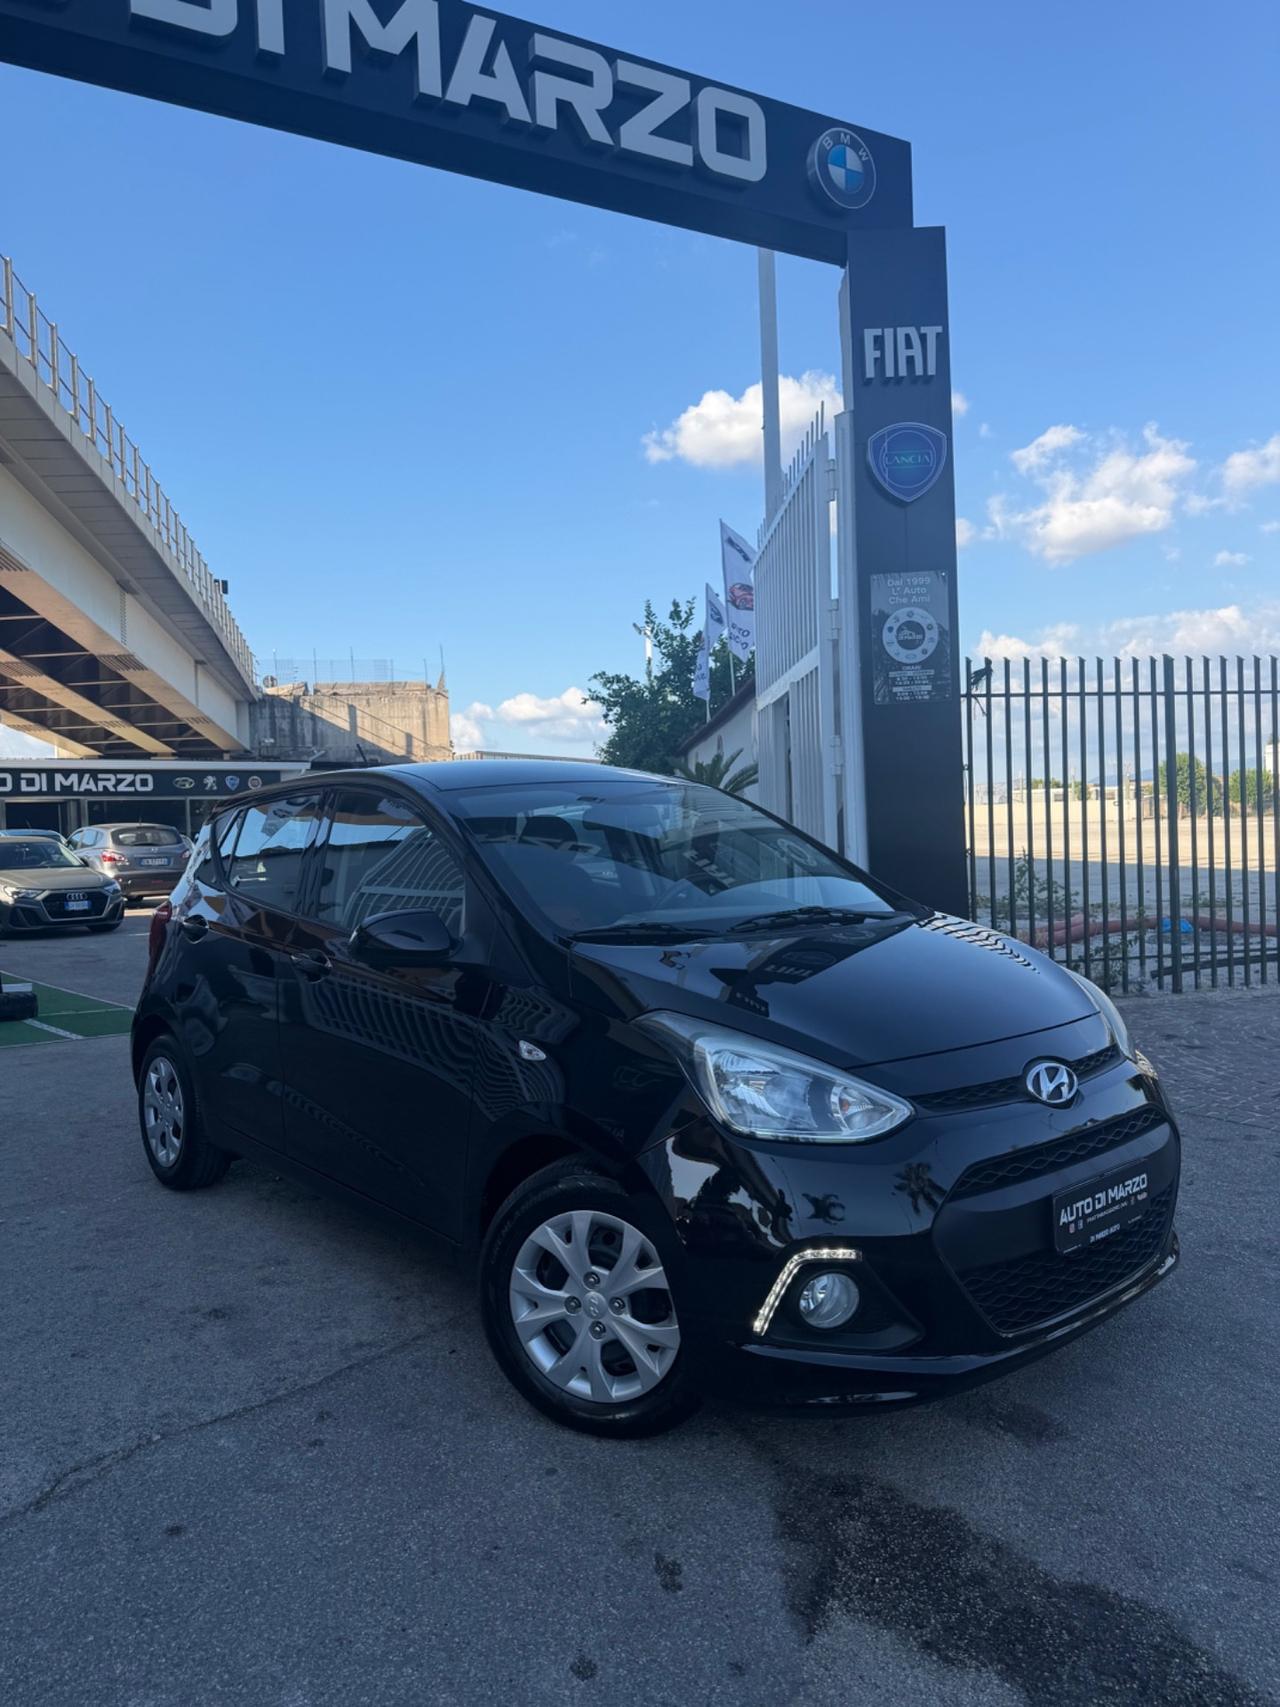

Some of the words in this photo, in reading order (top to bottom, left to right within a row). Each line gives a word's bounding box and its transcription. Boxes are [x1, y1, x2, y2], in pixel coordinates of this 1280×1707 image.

[323, 0, 767, 182] MARZO
[822, 132, 869, 161] BMW
[863, 325, 943, 379] FIAT
[886, 453, 931, 466] LANCIA
[20, 773, 48, 792] DI
[54, 773, 154, 792] MARZO
[1059, 1197, 1093, 1226] AUTO
[1095, 1191, 1107, 1210] DI
[1108, 1173, 1148, 1204] MARZO
